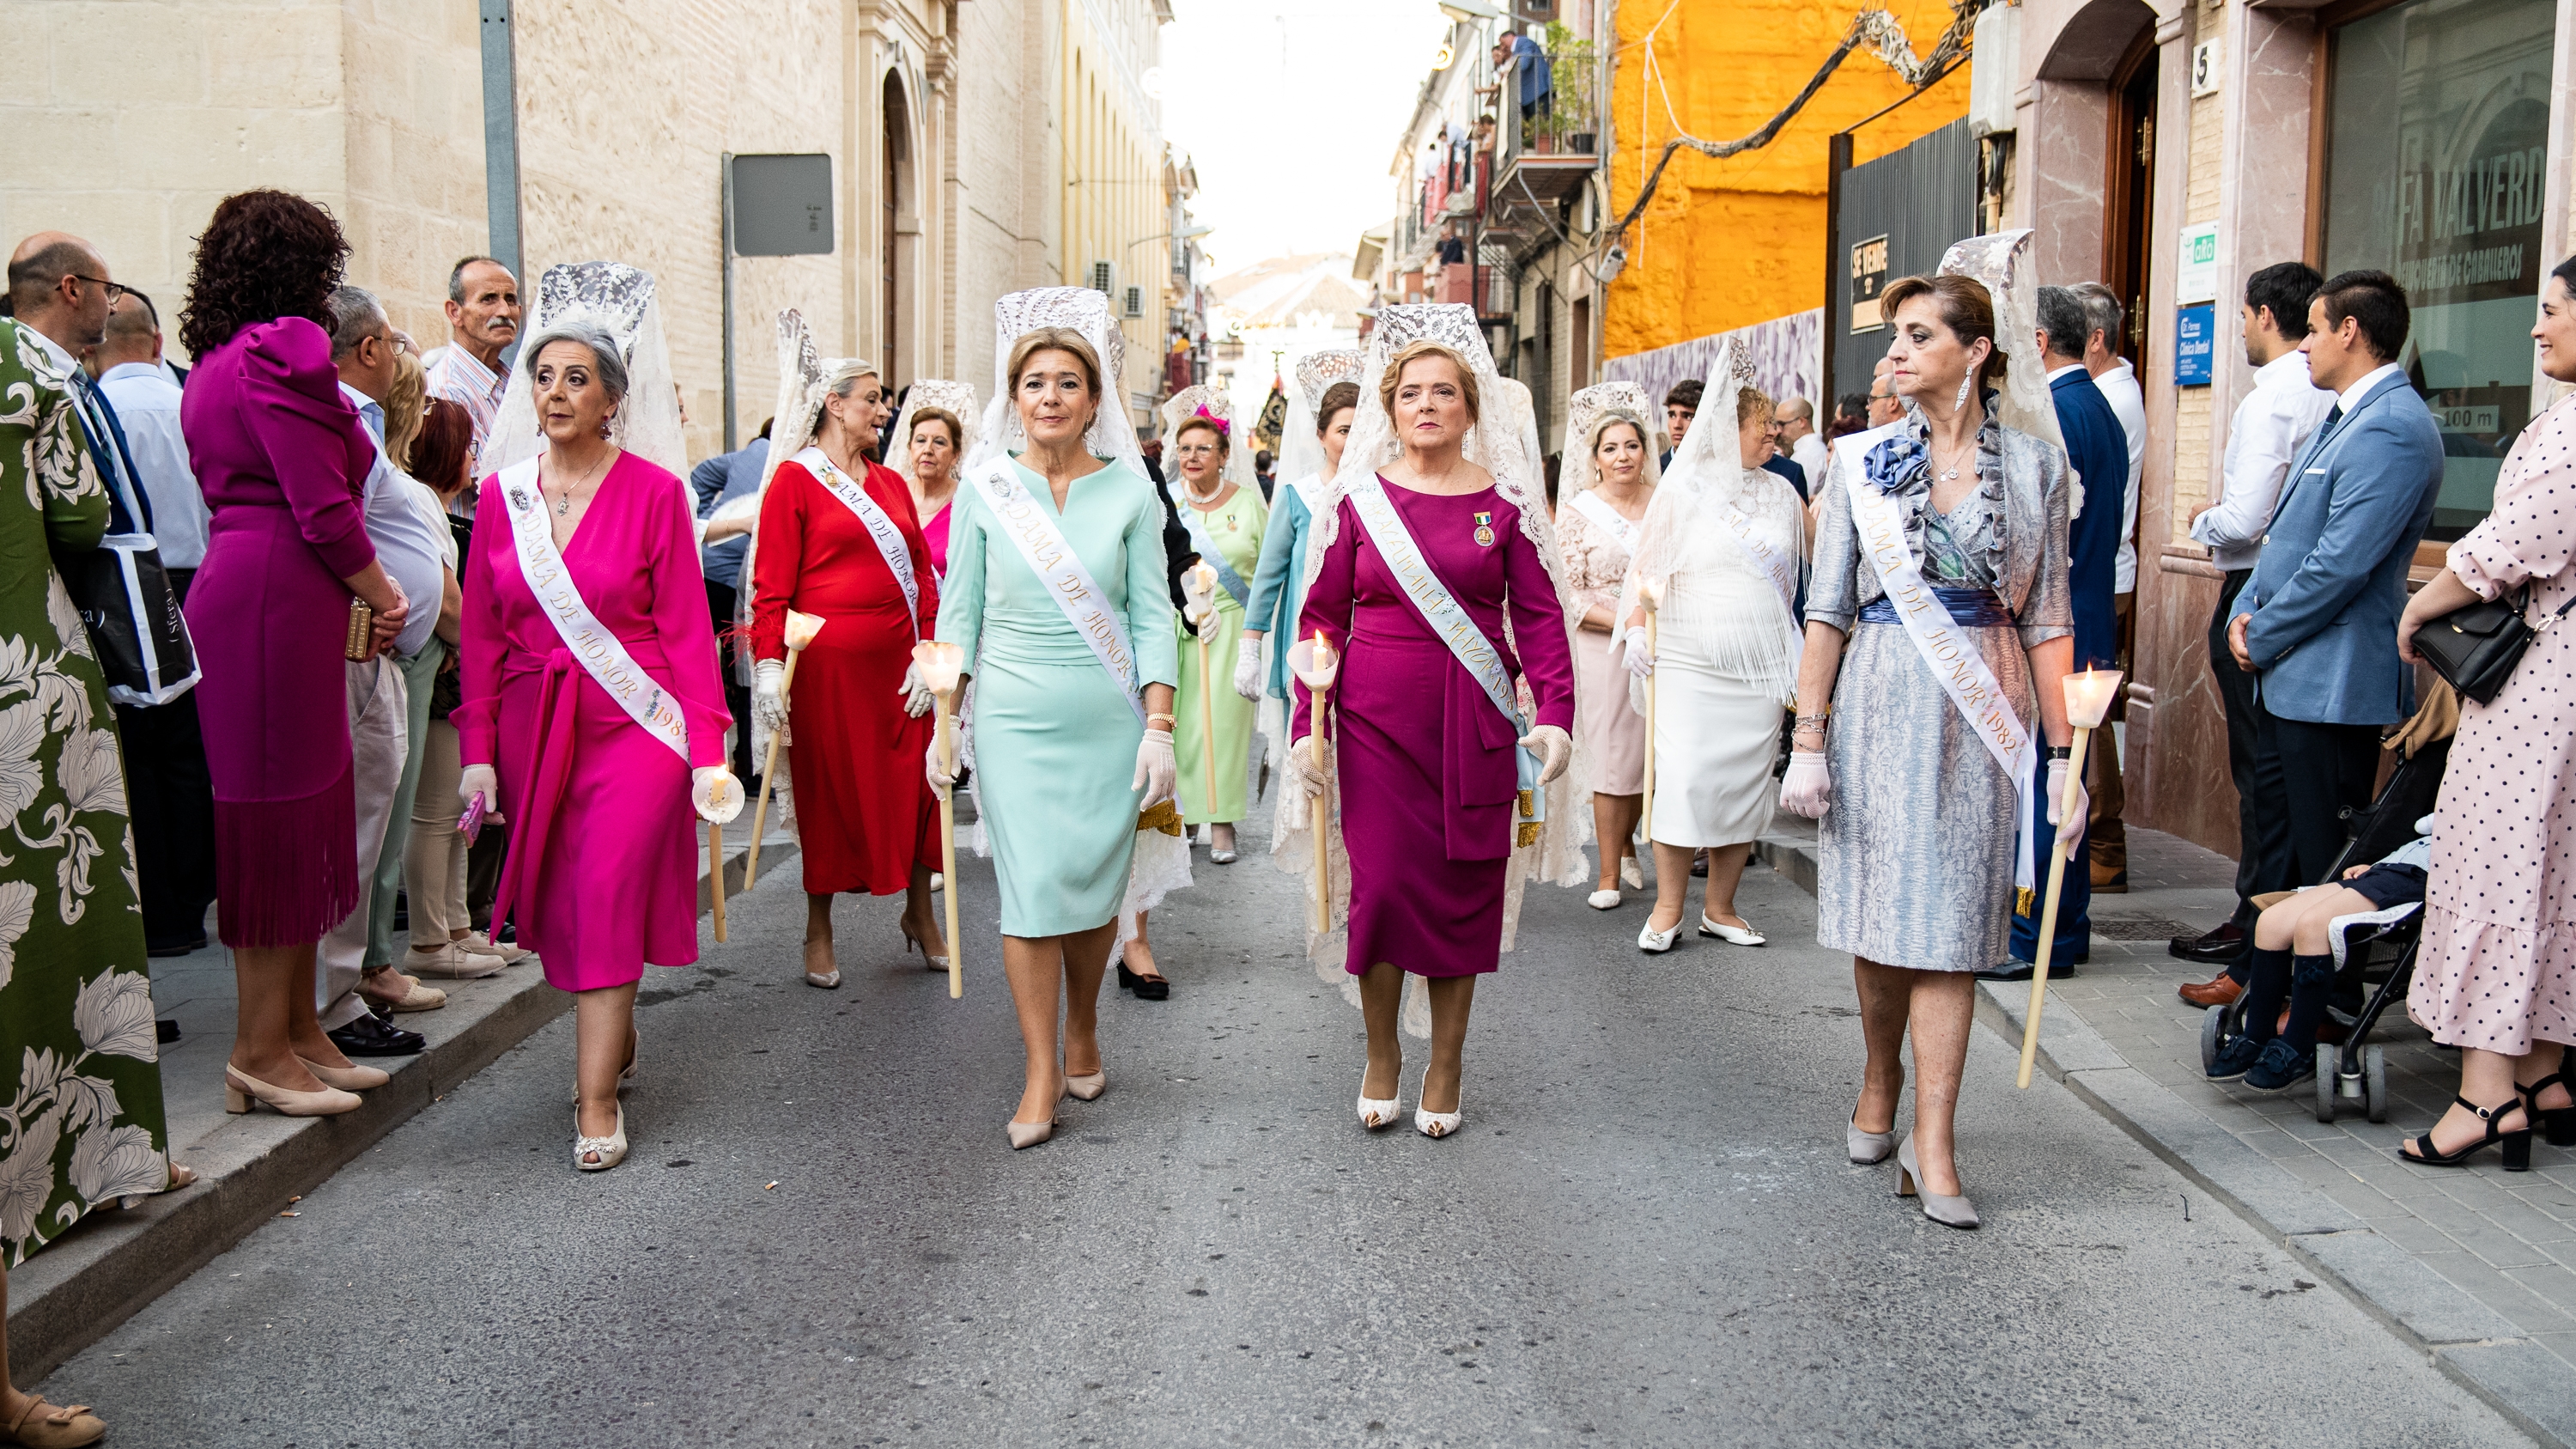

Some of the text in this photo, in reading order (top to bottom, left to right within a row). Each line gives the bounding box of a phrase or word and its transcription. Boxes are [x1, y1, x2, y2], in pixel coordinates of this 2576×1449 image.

[2196, 46, 2208, 85] 5
[1853, 240, 1887, 279] SE VENDE
[2448, 253, 2463, 288] DE
[2464, 243, 2524, 286] CABALLEROS
[2443, 410, 2493, 428] 100 m
[870, 517, 894, 541] DE
[886, 545, 918, 604] HONOR
[1751, 539, 1774, 563] DE
[522, 514, 558, 589] DAMA
[550, 591, 580, 624] DE
[572, 629, 638, 700] HONOR
[1006, 503, 1132, 678] DAMA DE HONOR
[1363, 502, 1444, 611] ARACELITANA
[1444, 620, 1495, 678] MAYOR
[1861, 490, 2017, 756] DAMA DE HONOR 1982
